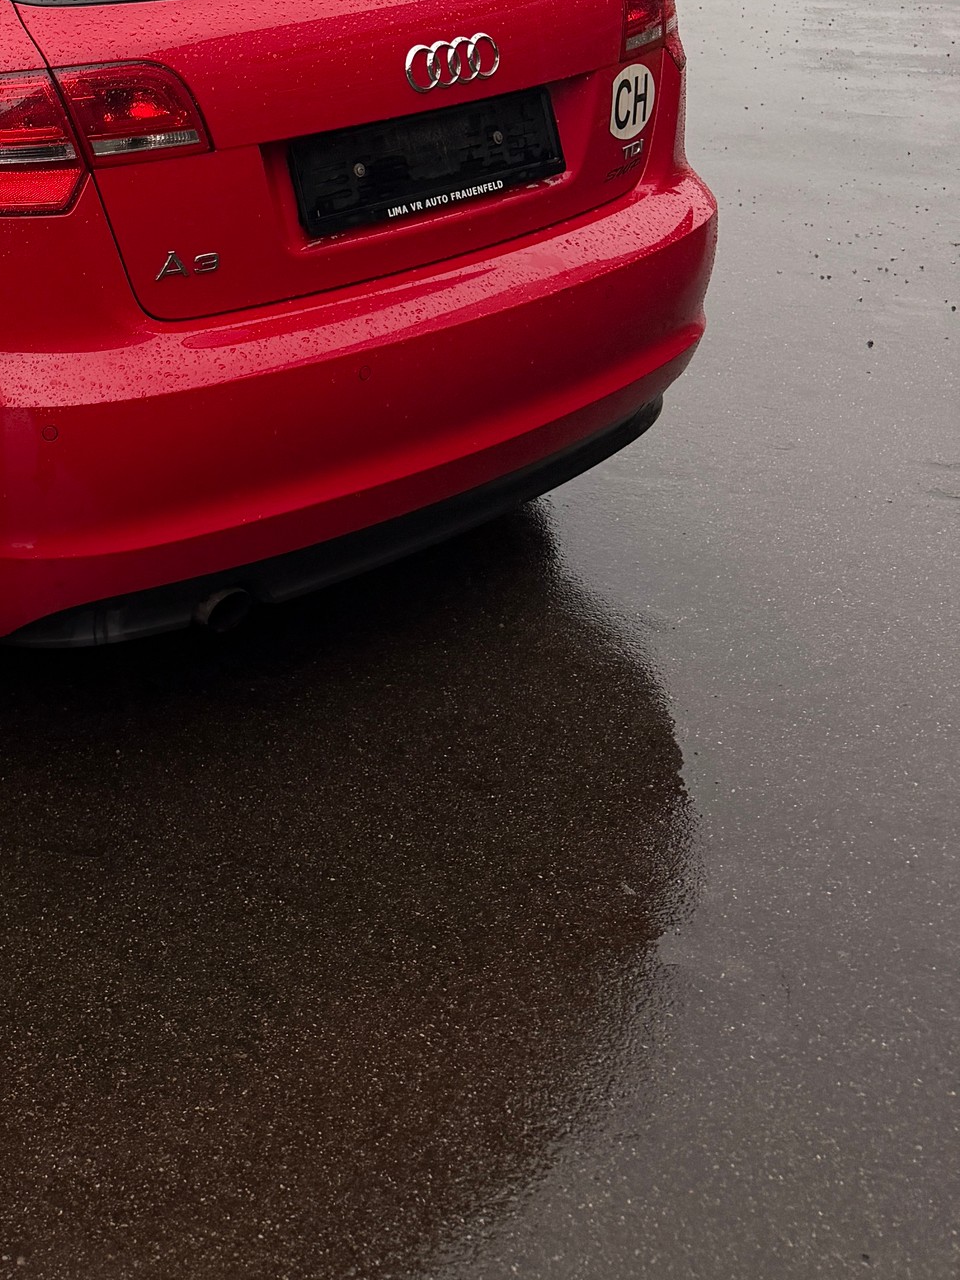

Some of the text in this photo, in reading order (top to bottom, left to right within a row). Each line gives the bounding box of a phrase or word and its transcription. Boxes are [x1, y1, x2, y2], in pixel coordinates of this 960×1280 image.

[615, 73, 648, 130] CH
[622, 138, 644, 160] TDI
[387, 180, 504, 217] LIMA VR AUTO FRAUENFELD
[155, 250, 218, 281] A3
